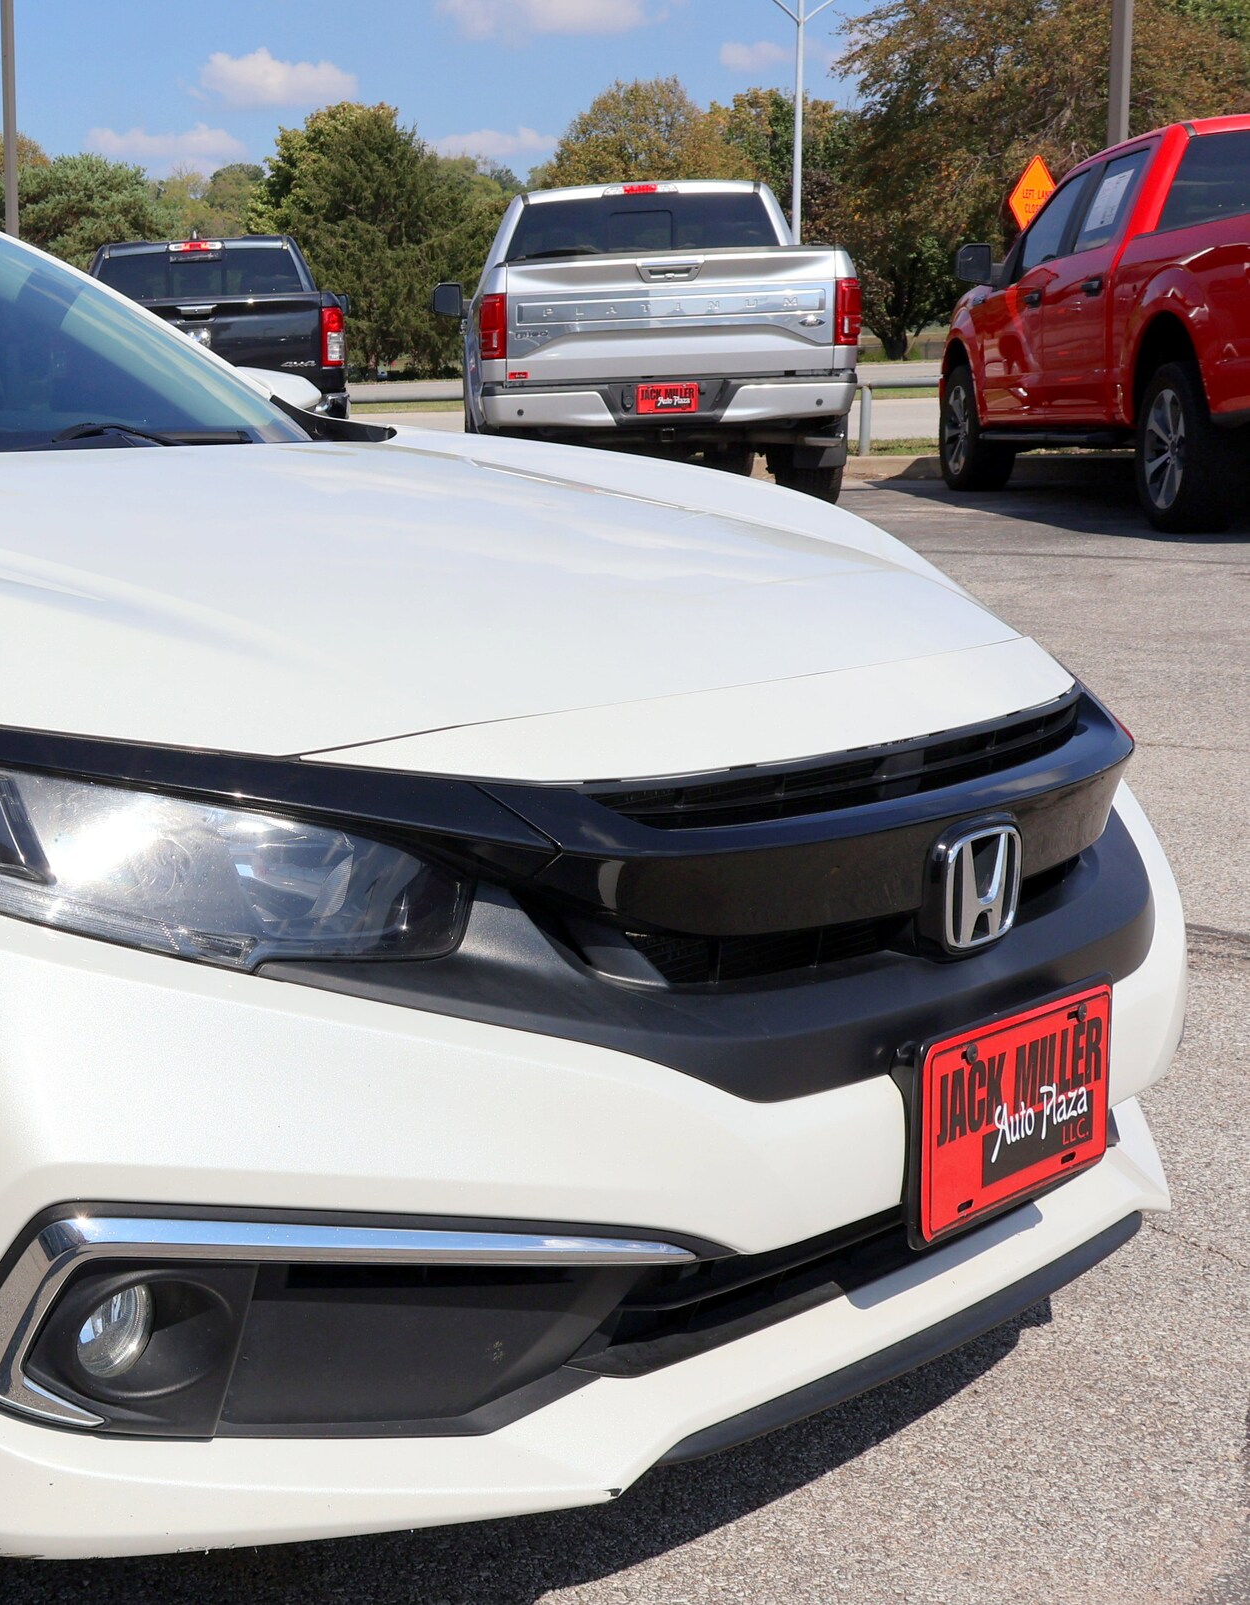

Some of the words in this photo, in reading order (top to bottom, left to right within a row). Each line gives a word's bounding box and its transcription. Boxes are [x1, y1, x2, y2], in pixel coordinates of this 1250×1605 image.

[1022, 188, 1035, 199] LEFT
[1025, 203, 1042, 213] CLOS
[542, 296, 799, 317] PLATINUM
[640, 388, 662, 401] JACK
[664, 387, 695, 400] MILLER
[937, 1051, 1007, 1148] JACK
[1014, 1016, 1103, 1110] MILLER
[990, 1101, 1035, 1164] Auto
[1039, 1083, 1088, 1140] Plaza
